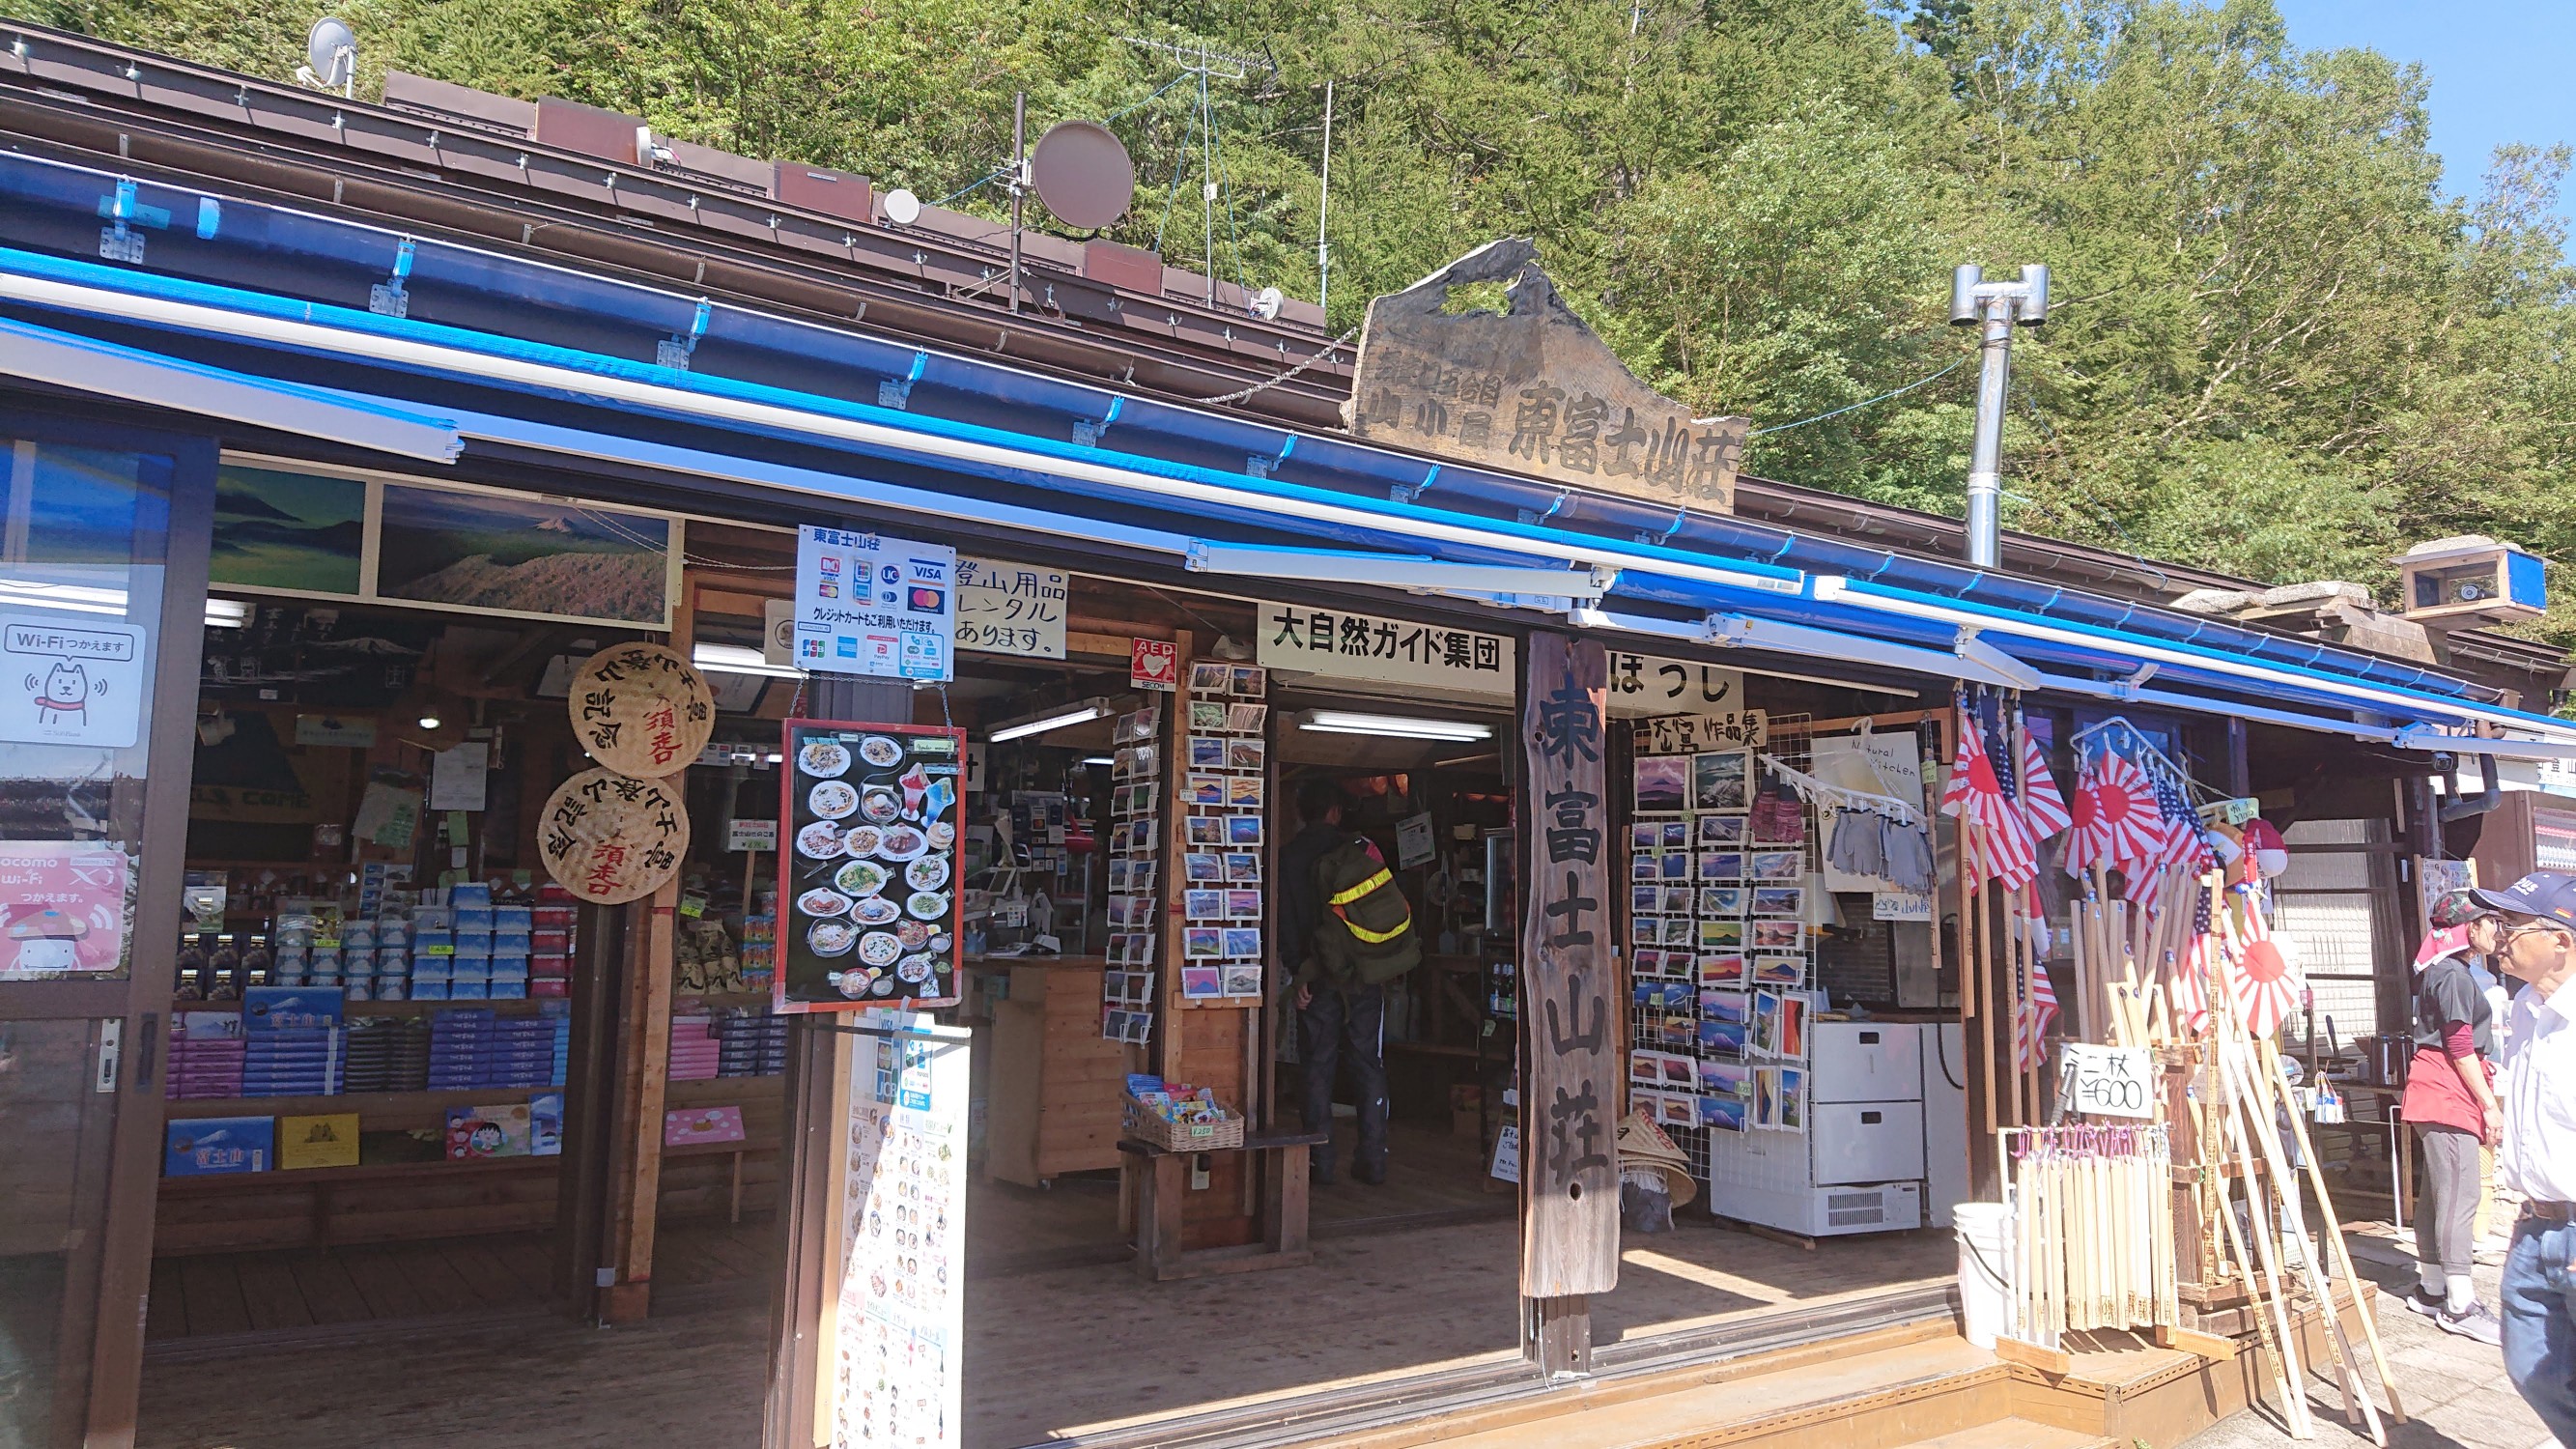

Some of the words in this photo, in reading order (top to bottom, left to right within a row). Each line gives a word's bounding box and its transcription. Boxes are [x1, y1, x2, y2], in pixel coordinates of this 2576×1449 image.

[1508, 381, 1738, 504] 東富士山荘
[813, 527, 881, 552] 東富士山荘
[882, 569, 899, 582] UC
[913, 566, 943, 580] VISA
[954, 558, 1065, 600] 登山用品
[957, 594, 1059, 622] レンタル
[813, 607, 936, 635] クレジットカードもご利用いただけます。
[803, 639, 826, 658] JCB
[954, 621, 1052, 654] あります。
[1137, 640, 1174, 656] AED
[1272, 610, 1501, 672] 大自然ガイド集団
[1142, 680, 1166, 691] SECOM
[0, 857, 58, 867] ocomo
[20, 893, 84, 903] つかえます。
[1539, 674, 1608, 1186] 東富士山荘
[877, 1081, 897, 1097] JCB
[2080, 1077, 2142, 1110] ¥600
